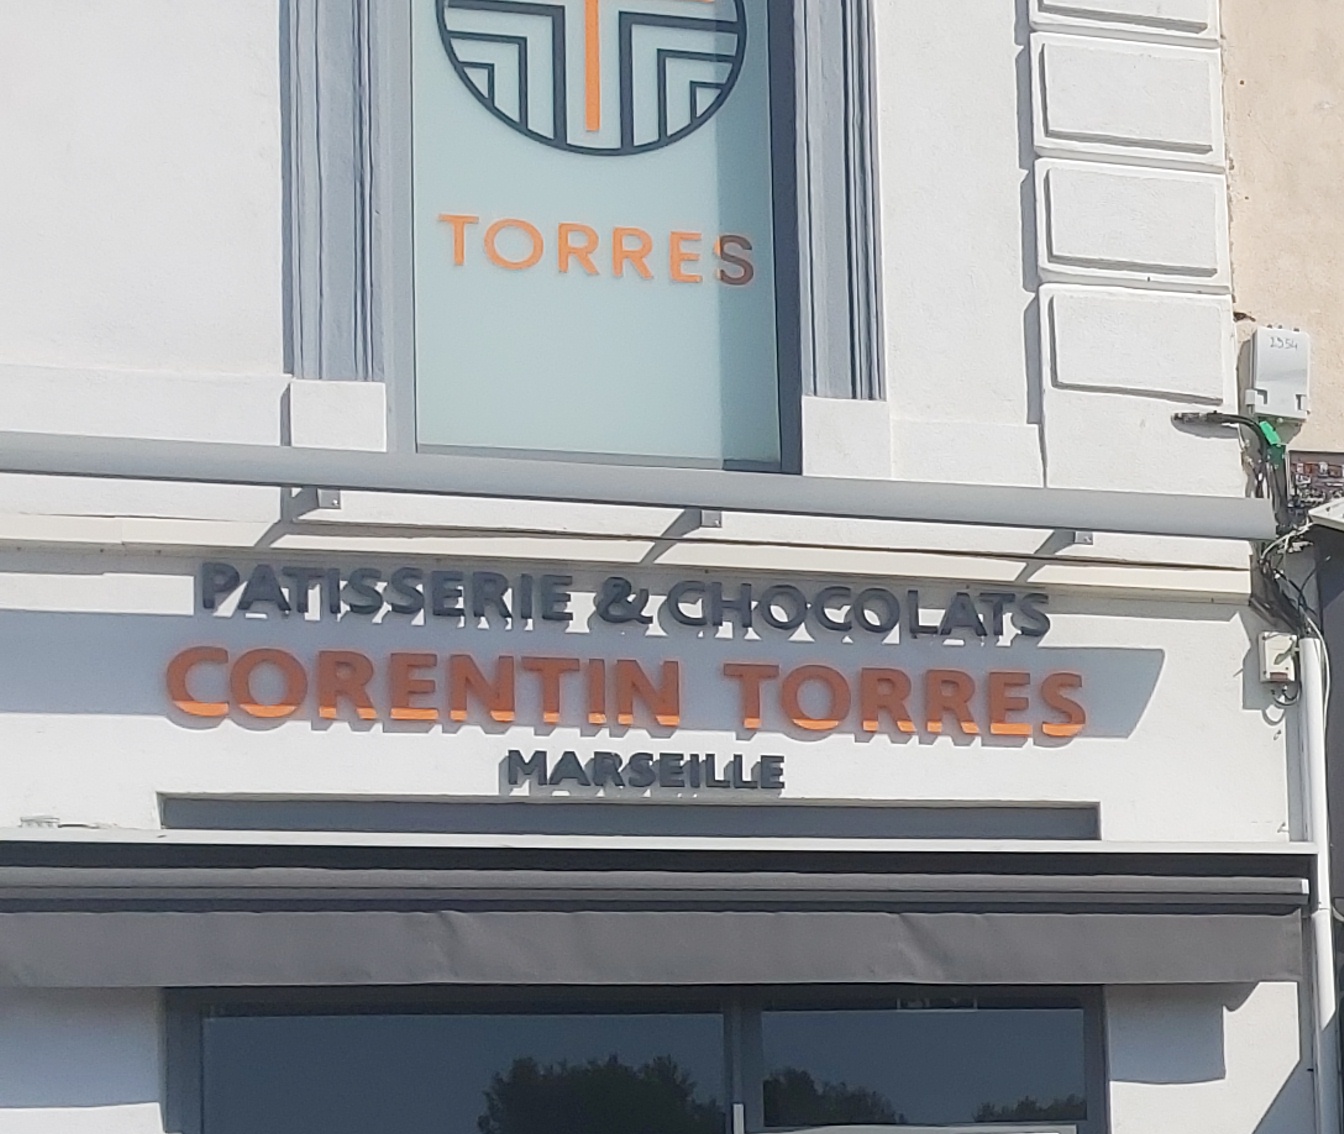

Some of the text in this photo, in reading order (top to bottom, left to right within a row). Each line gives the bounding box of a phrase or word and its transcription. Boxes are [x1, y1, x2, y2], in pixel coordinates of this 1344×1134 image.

[438, 214, 754, 287] TORRES
[202, 561, 1051, 638] PATISSERIE & CHOCOLATS
[165, 644, 1087, 738] CORENTIN TORRES
[507, 749, 785, 790] MARSEILLE
